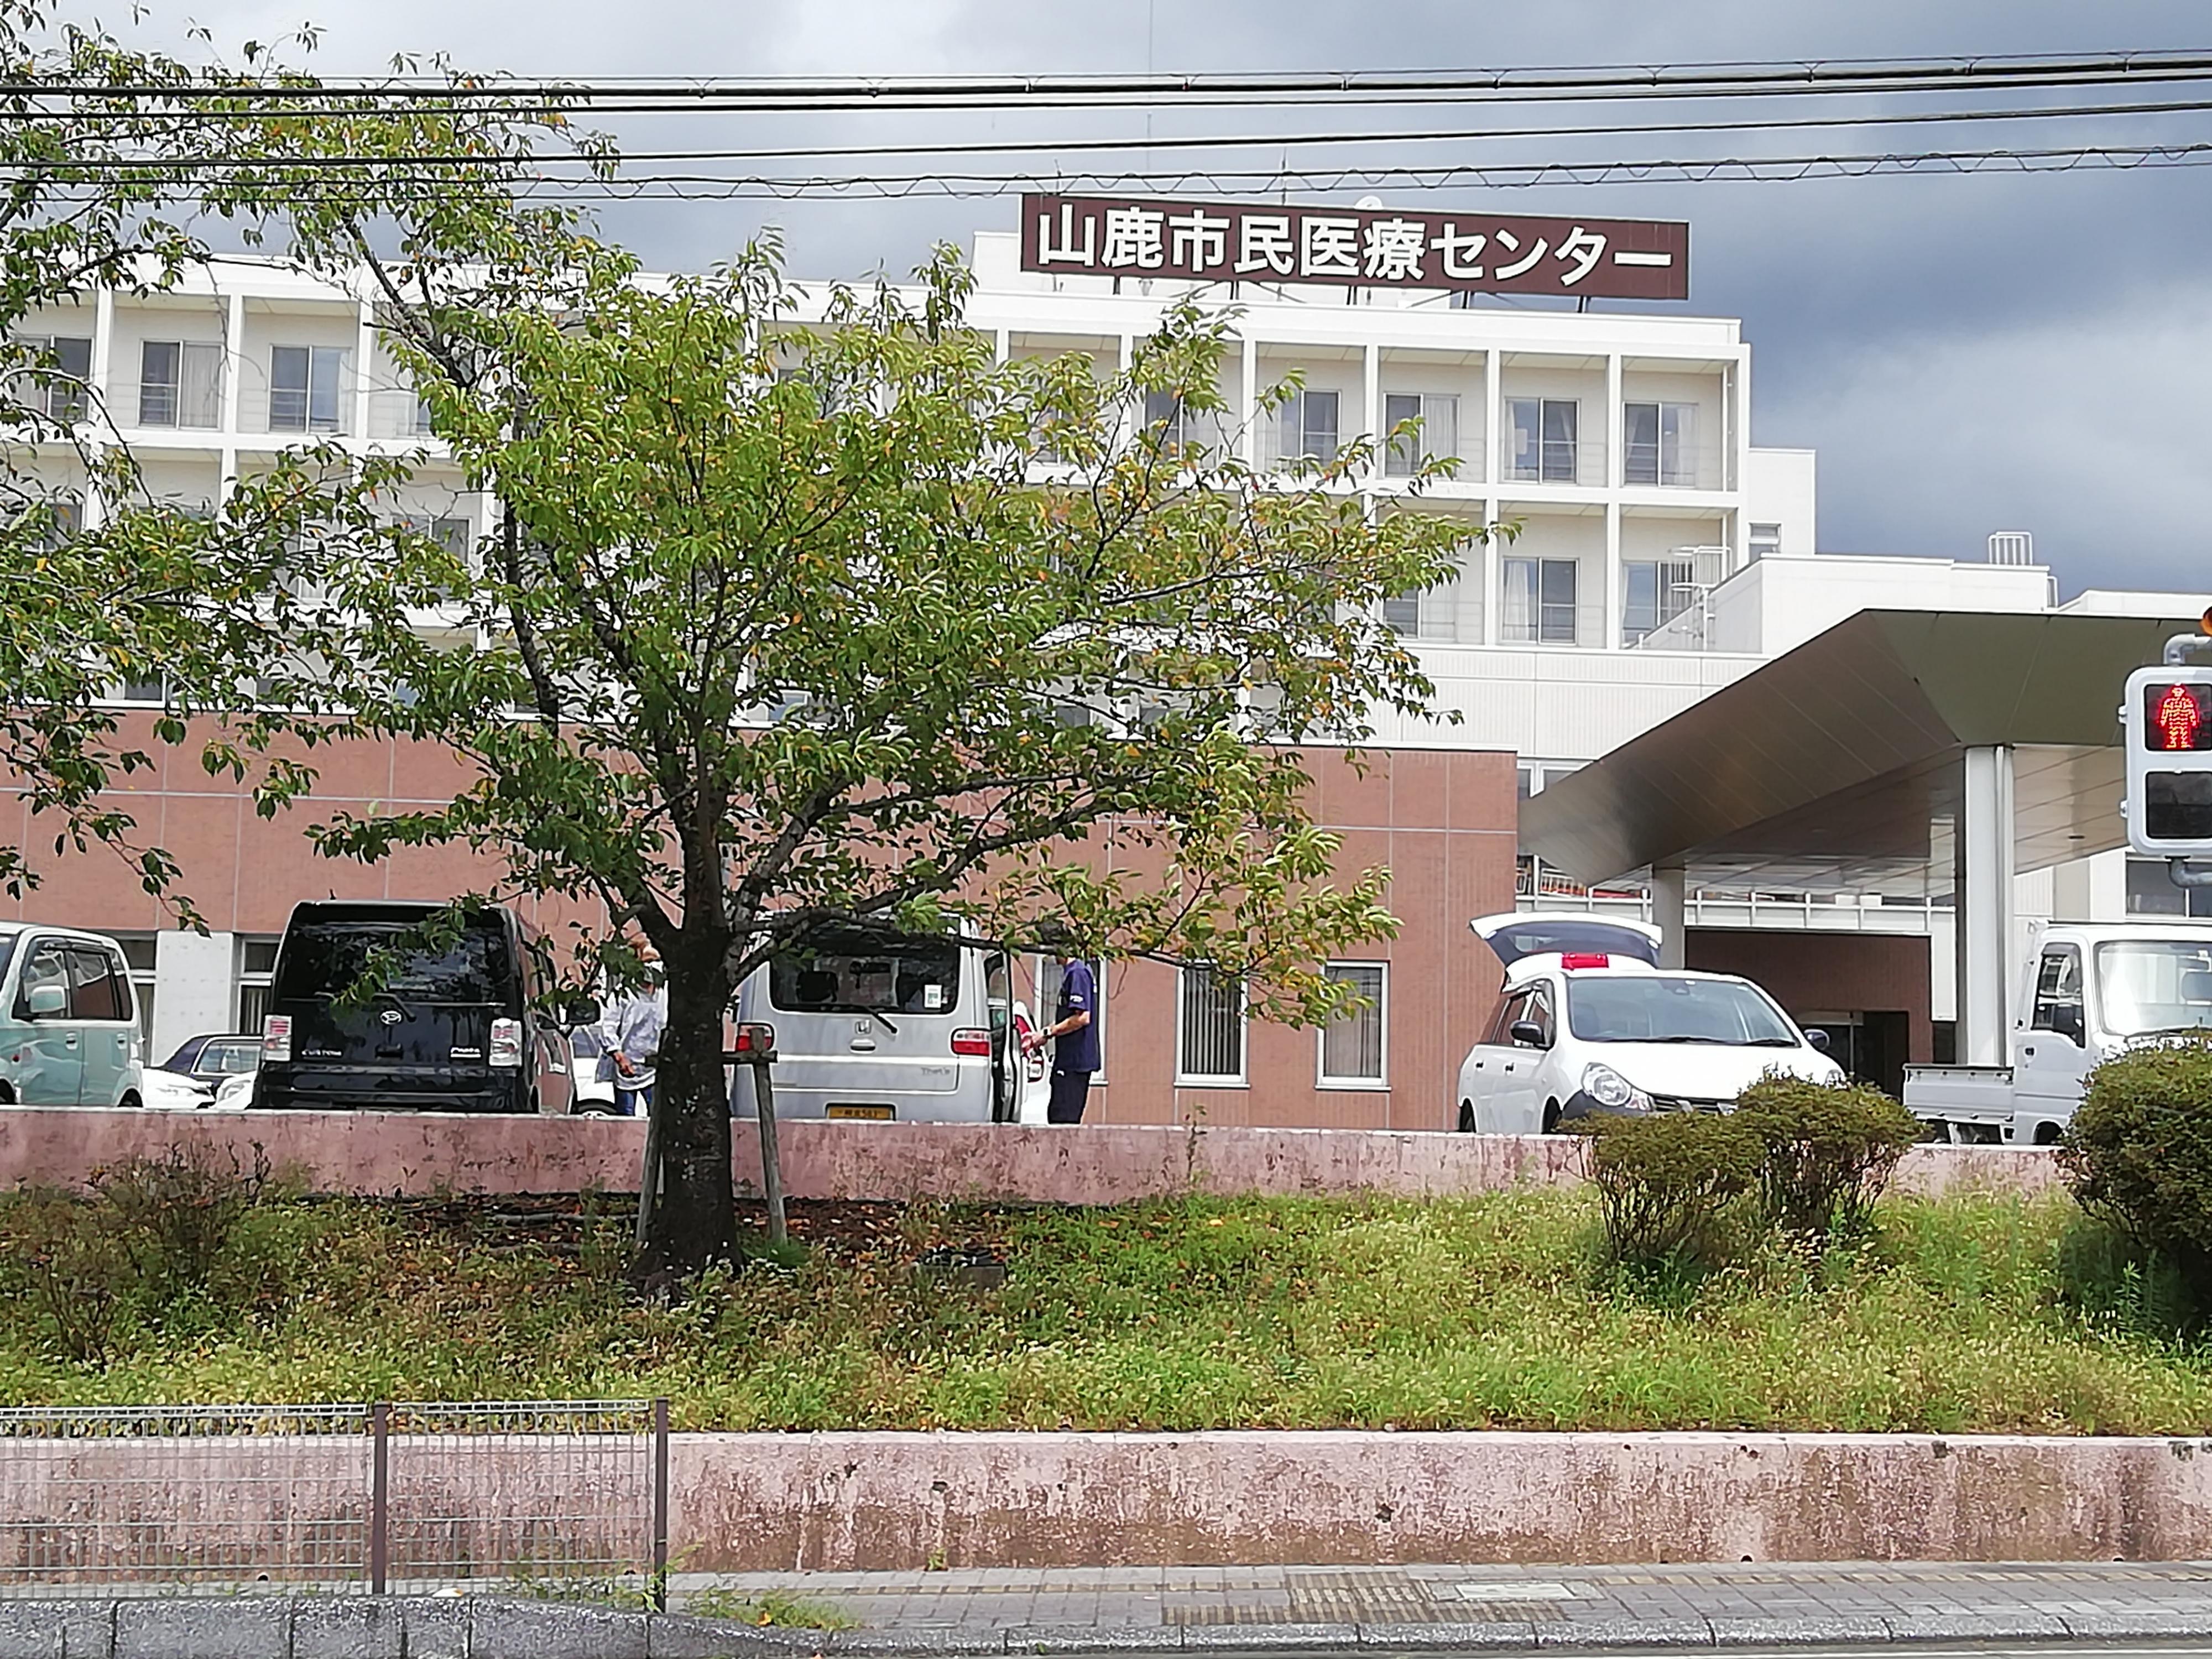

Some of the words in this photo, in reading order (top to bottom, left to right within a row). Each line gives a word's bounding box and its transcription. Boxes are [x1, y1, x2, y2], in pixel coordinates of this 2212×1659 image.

[1038, 204, 1672, 286] 山鹿市民医療センター
